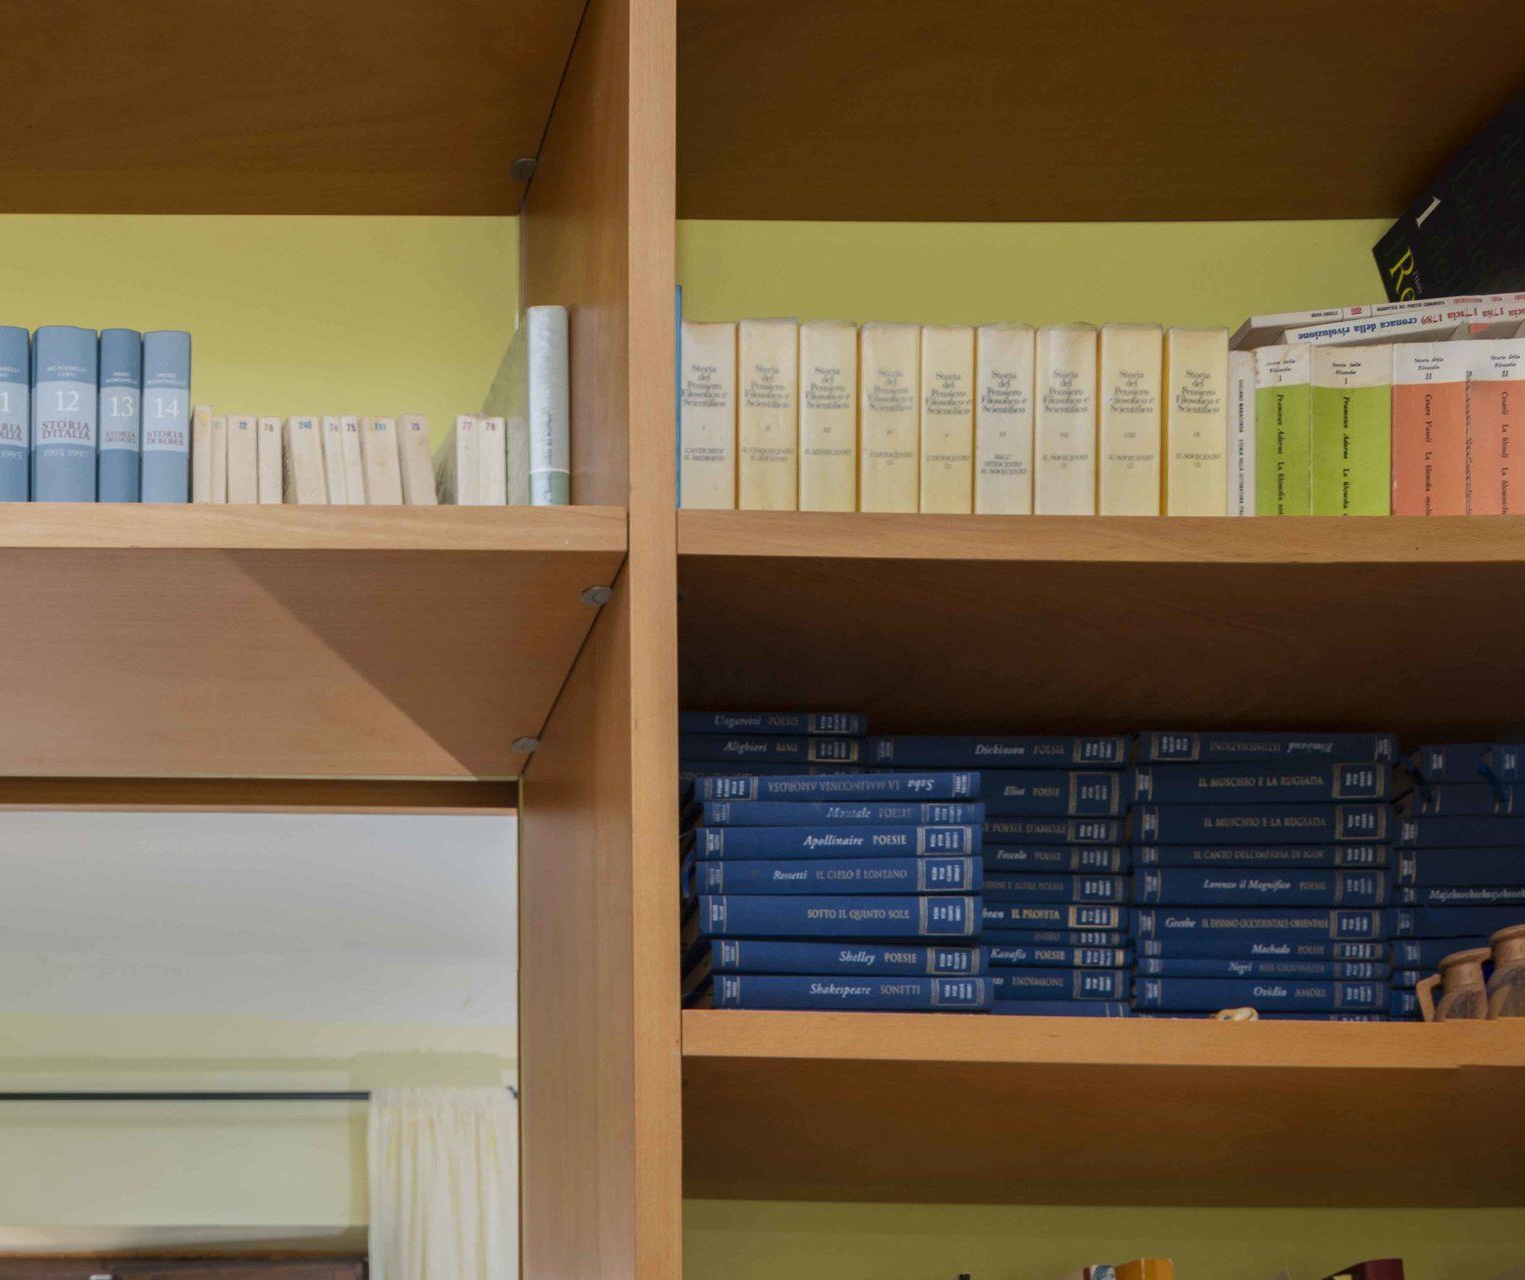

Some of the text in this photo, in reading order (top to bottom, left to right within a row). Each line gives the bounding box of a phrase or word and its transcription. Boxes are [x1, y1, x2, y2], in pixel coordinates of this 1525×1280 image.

[1379, 316, 1418, 331] cronaca
[803, 833, 907, 850] Apollinaire POESIE
[772, 869, 809, 881] Rossetti
[826, 869, 854, 880] CIELO
[864, 869, 908, 880] LONTANO
[806, 908, 837, 919] SOTTO
[849, 908, 886, 920] QUINTO
[888, 908, 910, 919] SOLE
[838, 950, 918, 965] Shelley POESIE
[809, 983, 921, 997] Shakespeare SONETTI
